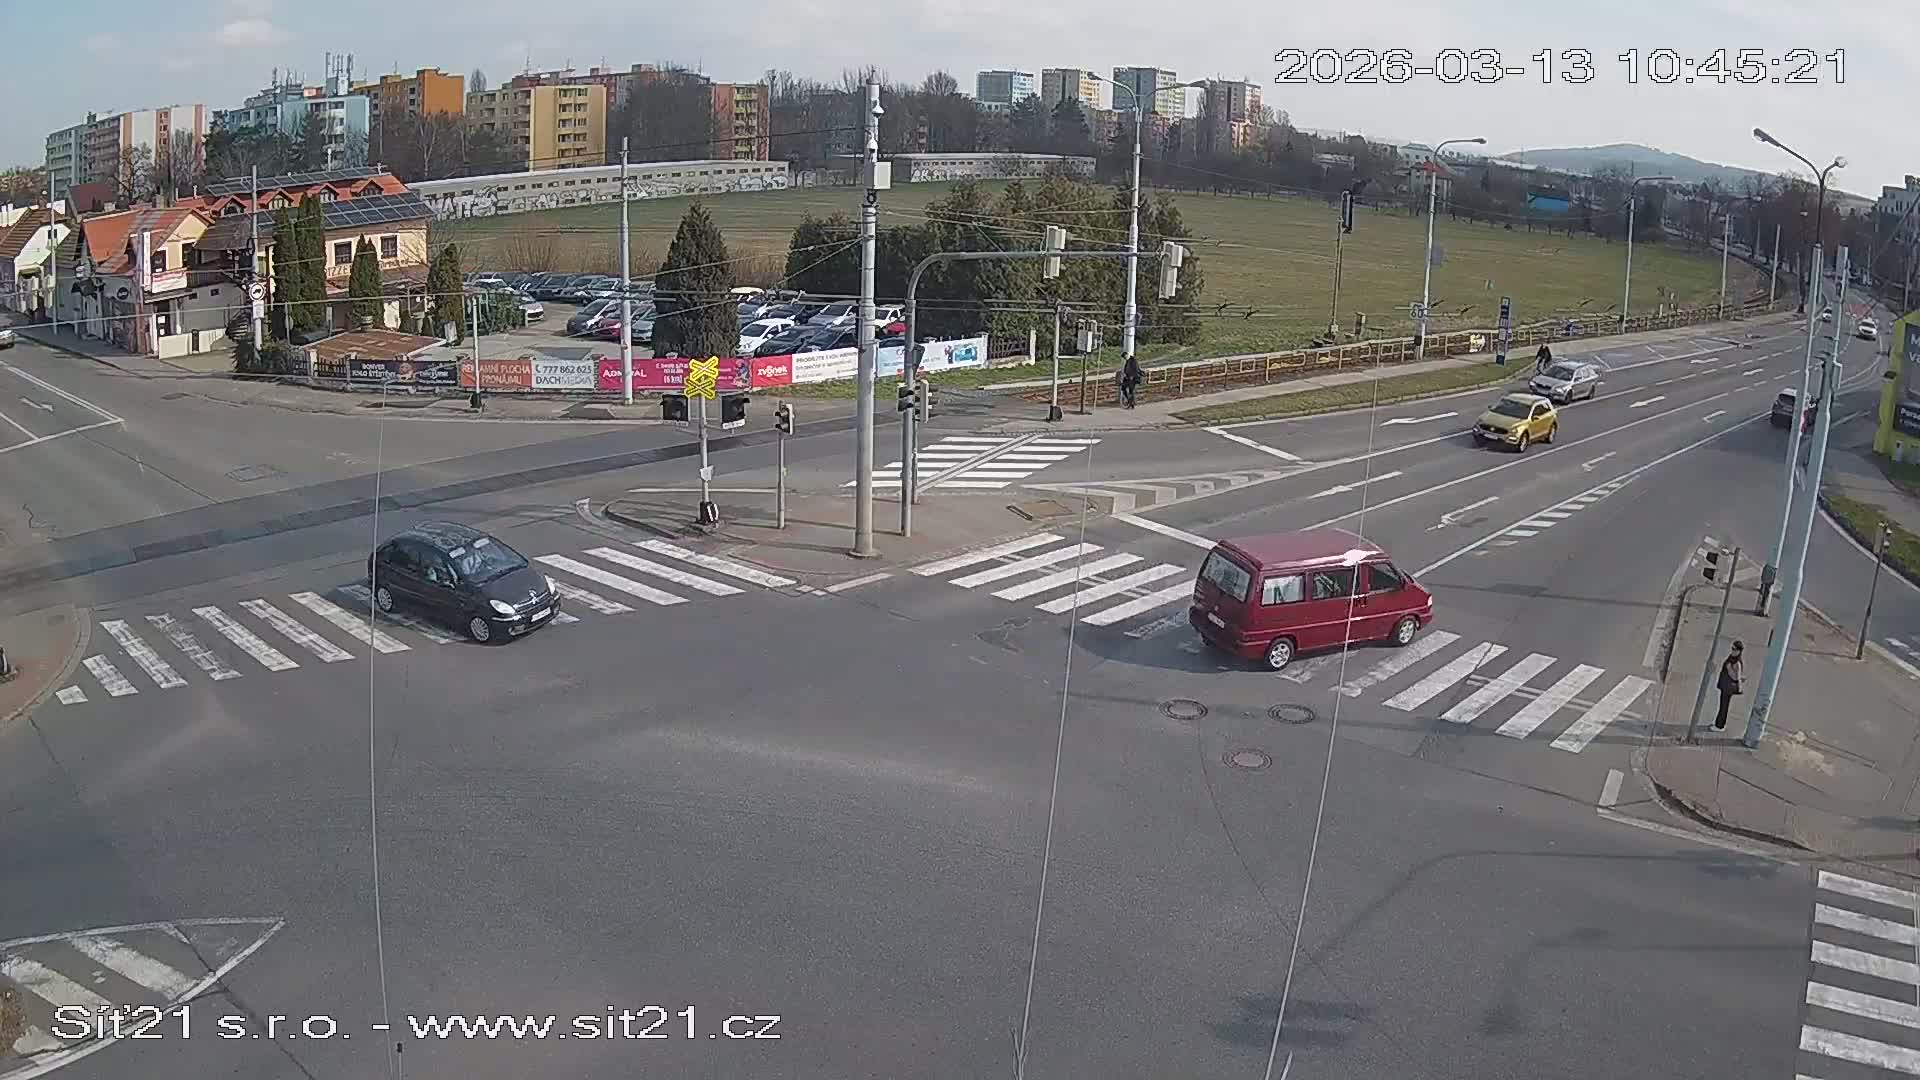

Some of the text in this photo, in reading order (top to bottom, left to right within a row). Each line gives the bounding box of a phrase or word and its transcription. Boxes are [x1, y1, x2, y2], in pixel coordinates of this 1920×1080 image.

[500, 364, 530, 374] PLOCHA
[543, 365, 592, 374] 777 862 625
[481, 374, 522, 385] PRONÁJMU
